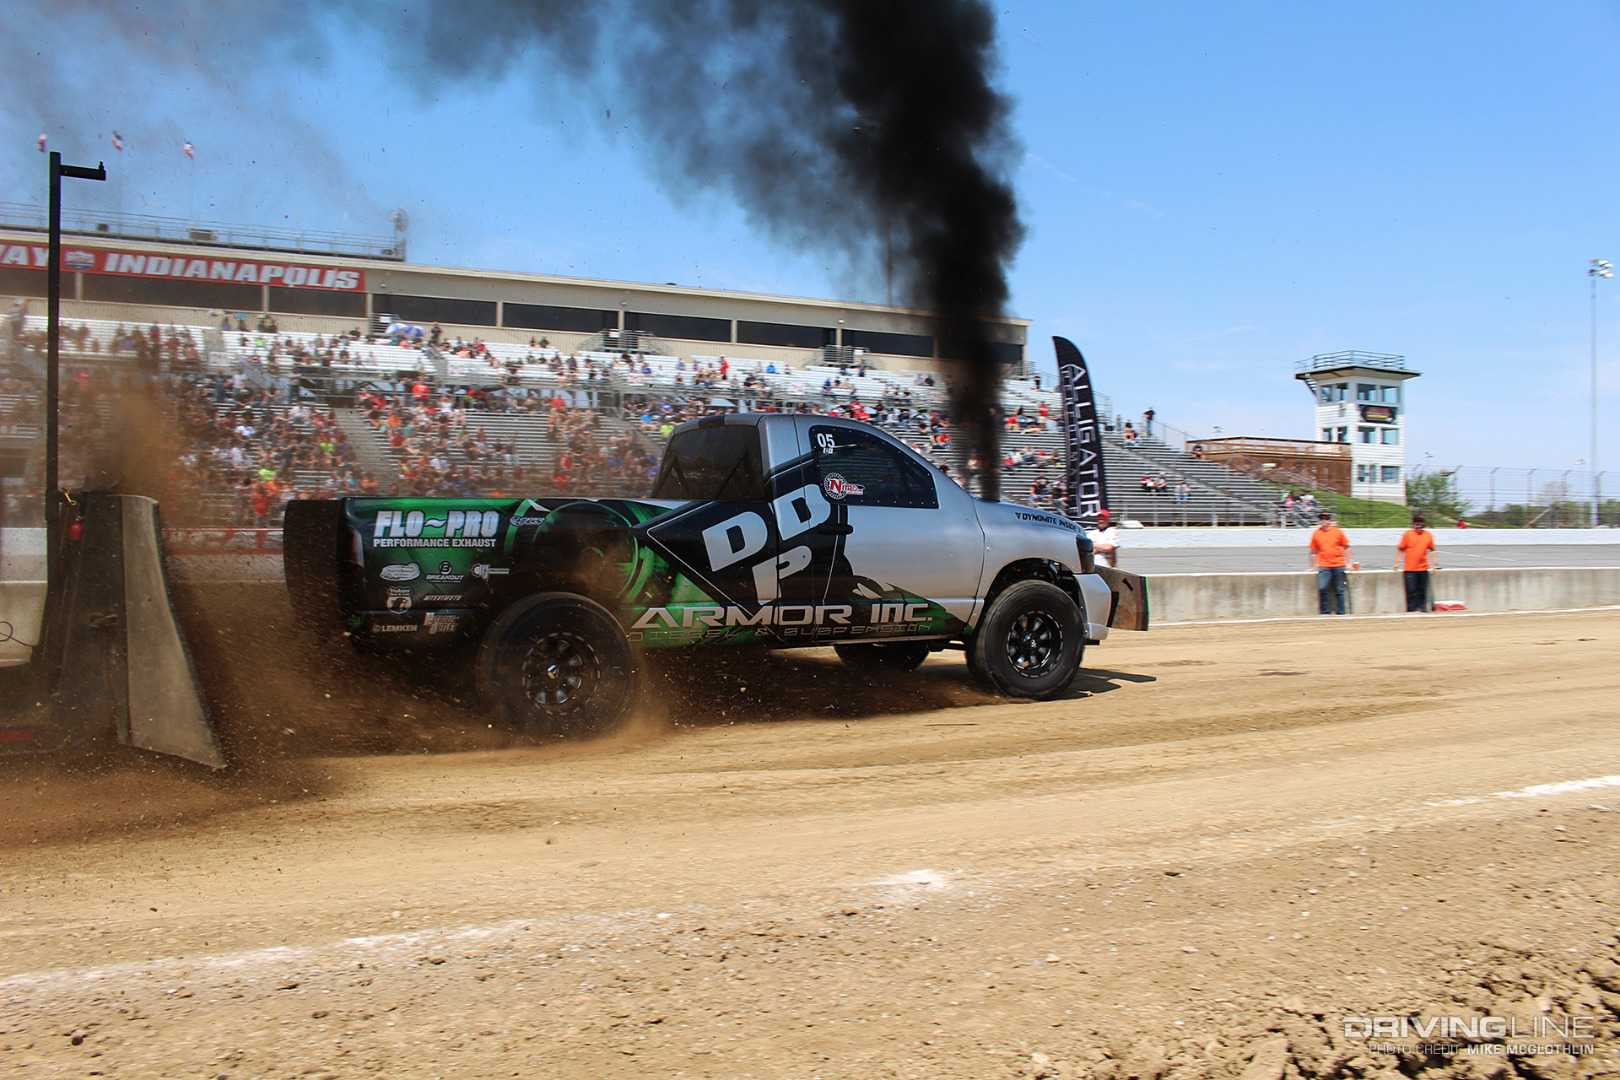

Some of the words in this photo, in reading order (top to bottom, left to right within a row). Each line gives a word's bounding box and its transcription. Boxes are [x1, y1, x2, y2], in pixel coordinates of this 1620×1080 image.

[0, 244, 49, 267] AY
[104, 251, 361, 290] INDIANAPOLIS
[817, 433, 836, 448] 05
[1071, 364, 1102, 517] ALLIGATOR
[1022, 512, 1058, 525] DYNOMITE
[1058, 519, 1078, 532] INSIDE
[373, 538, 450, 548] PERFORMANCE
[452, 538, 497, 548] EXHAUST
[631, 604, 853, 629] ARMOR
[381, 624, 418, 633] LEMKEN
[628, 629, 740, 642] DIESEL
[755, 628, 770, 636] &
[783, 624, 931, 637] SUSPENSION
